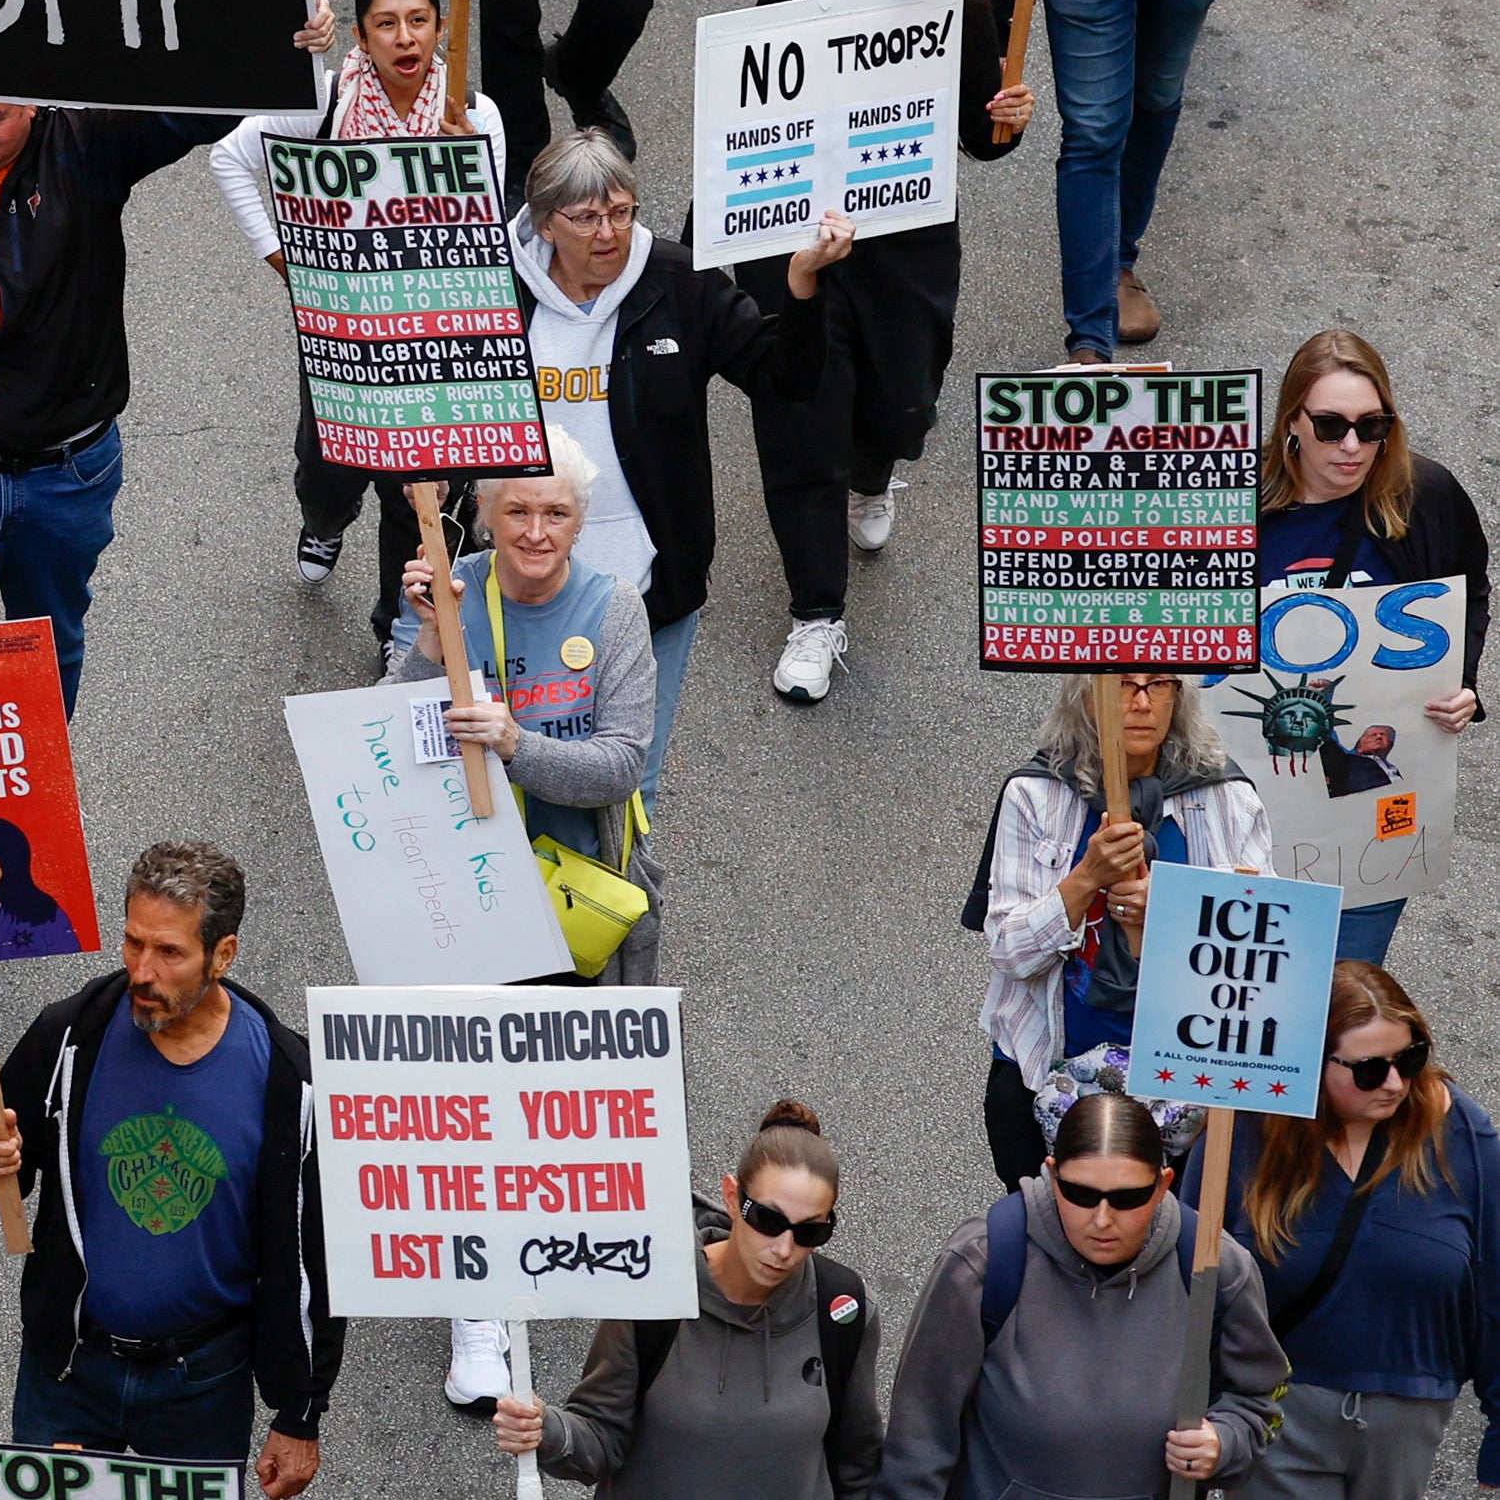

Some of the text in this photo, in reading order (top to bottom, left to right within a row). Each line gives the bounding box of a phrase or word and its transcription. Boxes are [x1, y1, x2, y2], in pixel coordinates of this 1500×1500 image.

[740, 9, 954, 108] NO TROOPS!
[727, 119, 815, 151] HANDS OFF
[724, 197, 811, 236] CHICAGO
[985, 378, 1249, 425] STOP THE
[984, 424, 1250, 450] TRUMP AGENDA!
[984, 529, 1254, 546] STOP POLICE CRIMES
[1197, 895, 1290, 946] ICE
[1188, 942, 1290, 983] OUT
[1210, 983, 1261, 1011] OF
[322, 1008, 671, 1063] INVADING CHICAGO
[1176, 1013, 1278, 1057] CHI
[1164, 1052, 1183, 1060] ALL
[1185, 1054, 1208, 1064] OUR
[1210, 1058, 1300, 1074] NEIGHBORHOODS
[329, 1089, 658, 1141] BECAUSE YOU'RE
[358, 1162, 646, 1213] ON THE EPSTEIN
[371, 1232, 652, 1280] LIST IS CRAZY
